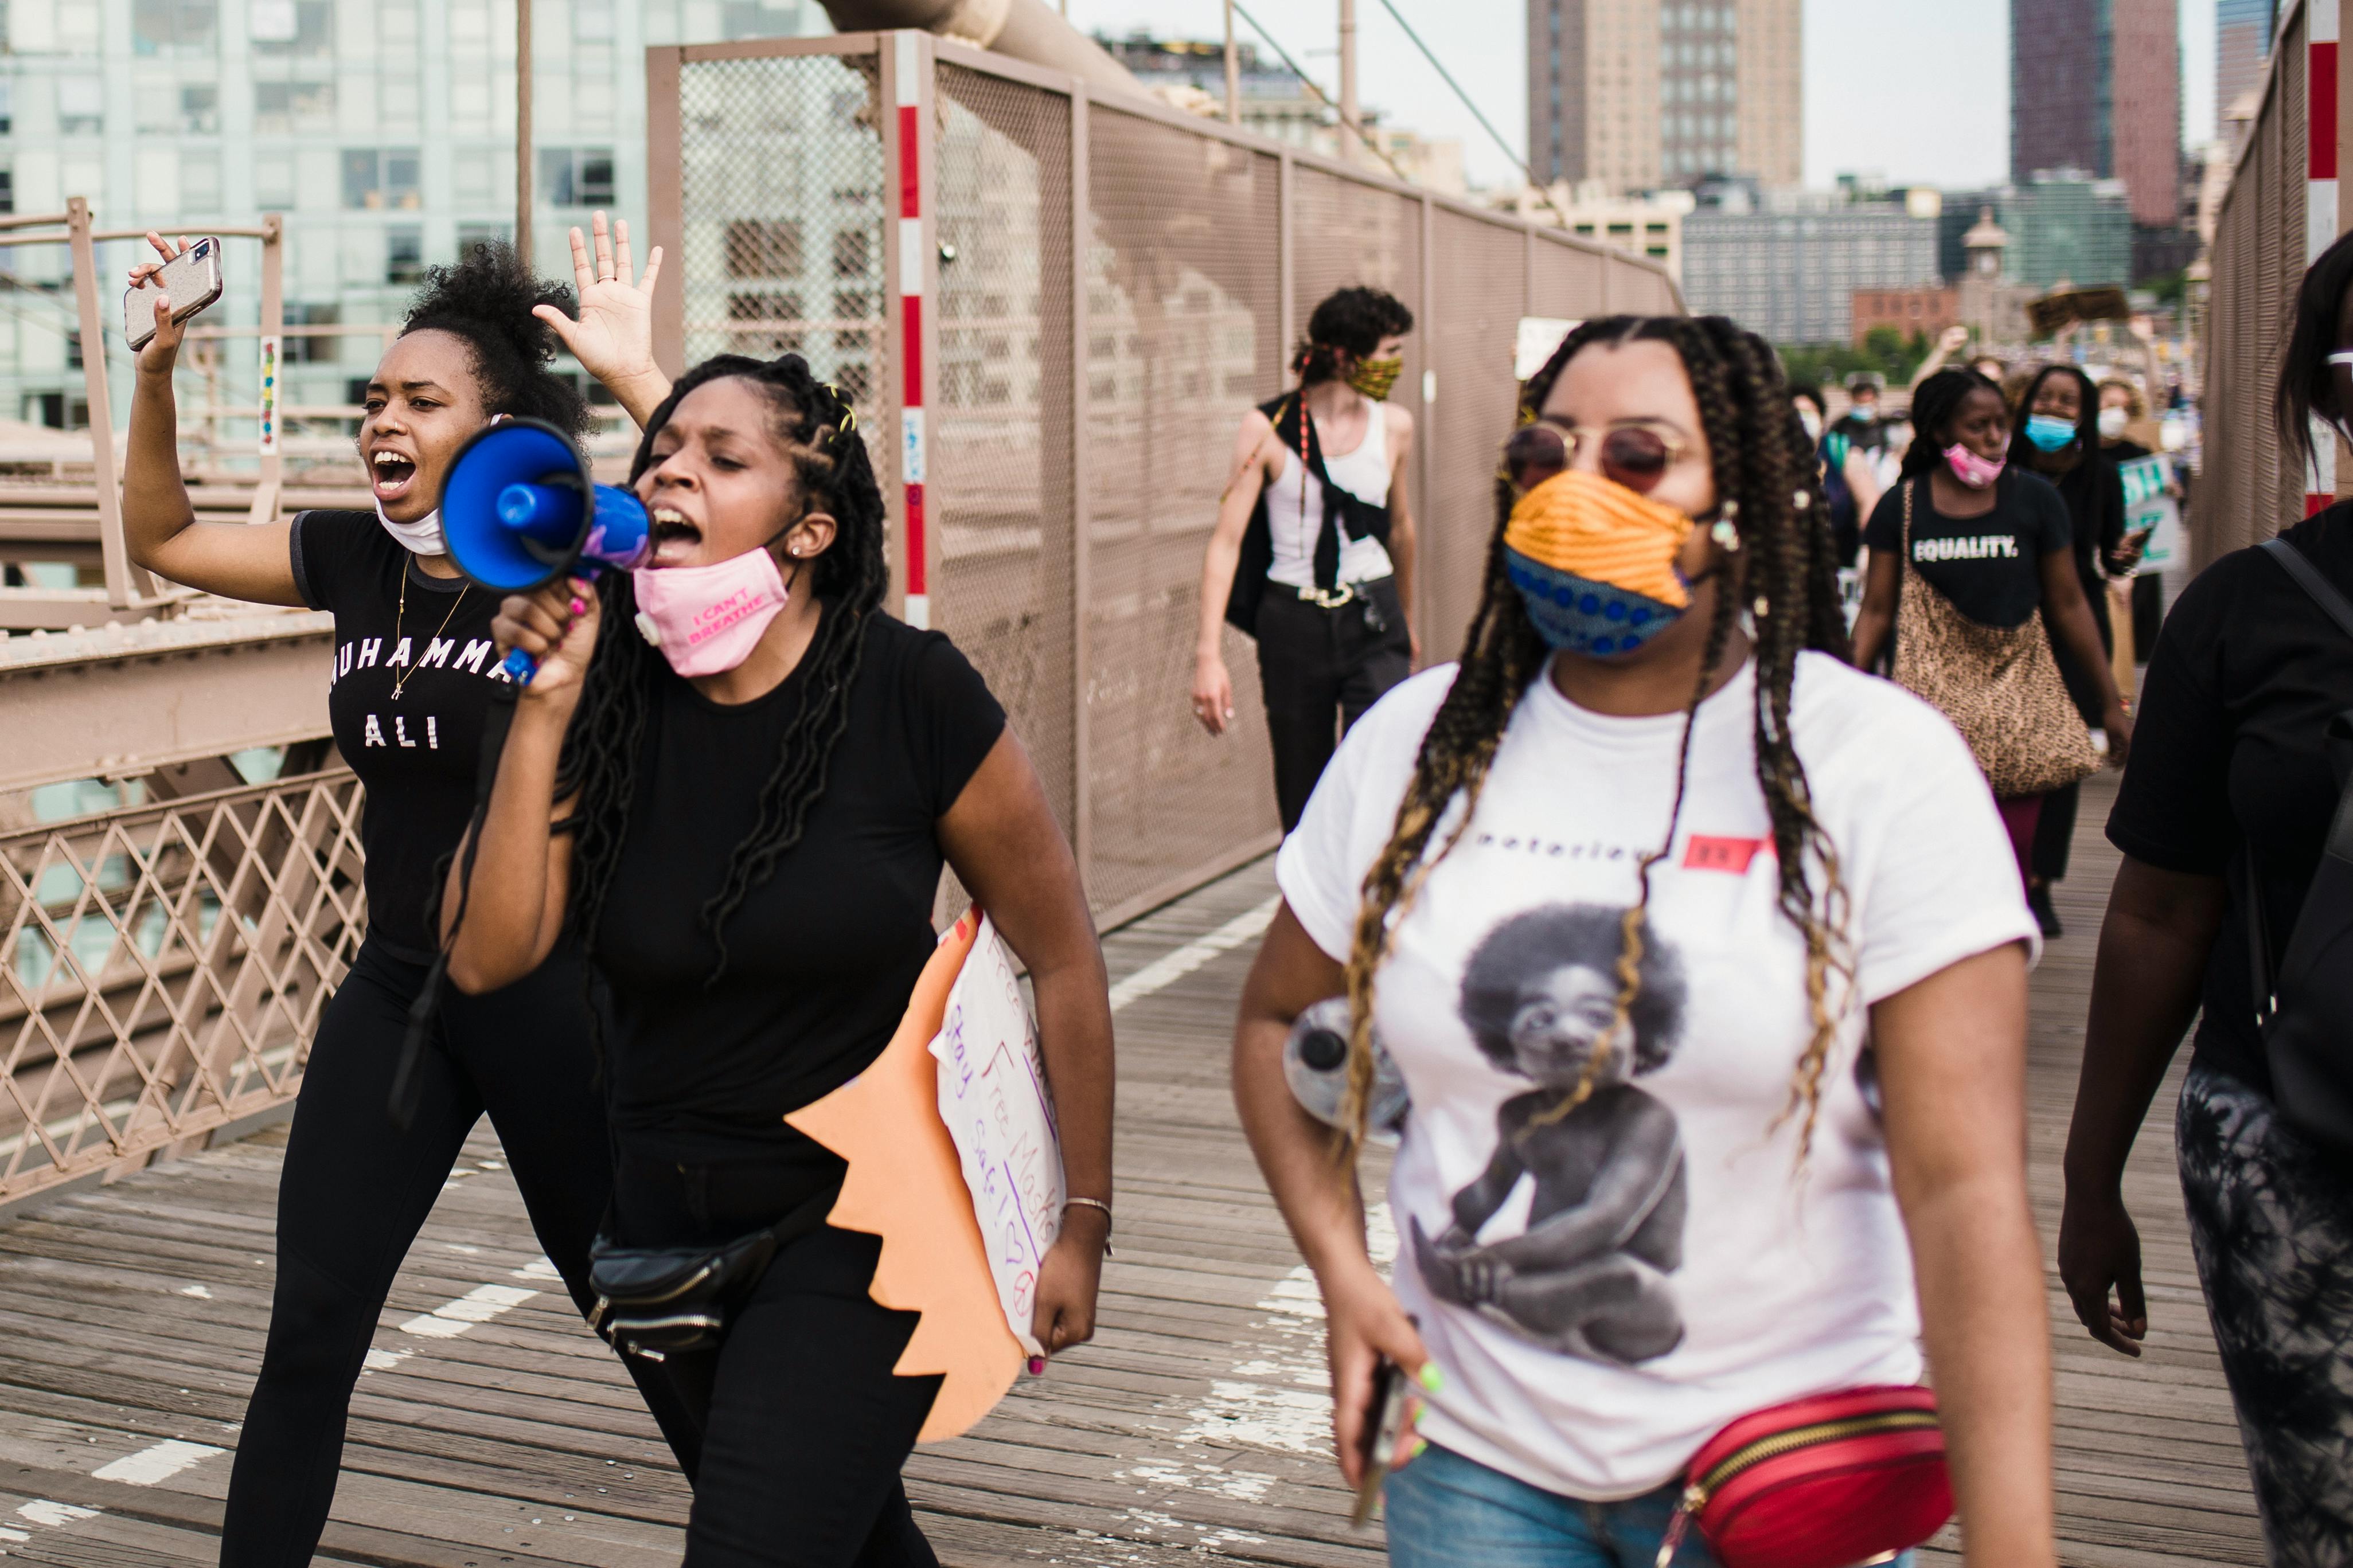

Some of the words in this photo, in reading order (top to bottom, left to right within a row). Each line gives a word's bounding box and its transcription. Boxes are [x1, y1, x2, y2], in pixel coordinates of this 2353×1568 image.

[1914, 534, 2019, 562] EQUALITY.
[689, 595, 763, 644] BREATHE
[693, 615, 701, 626] I
[329, 637, 513, 695] UHAMMA
[365, 714, 438, 749] ALI
[987, 929, 1019, 1018] Free
[946, 1003, 974, 1100] Stay
[970, 1119, 1008, 1229] Safe!
[981, 1040, 1014, 1138] Free
[1009, 1129, 1056, 1243] Masks
